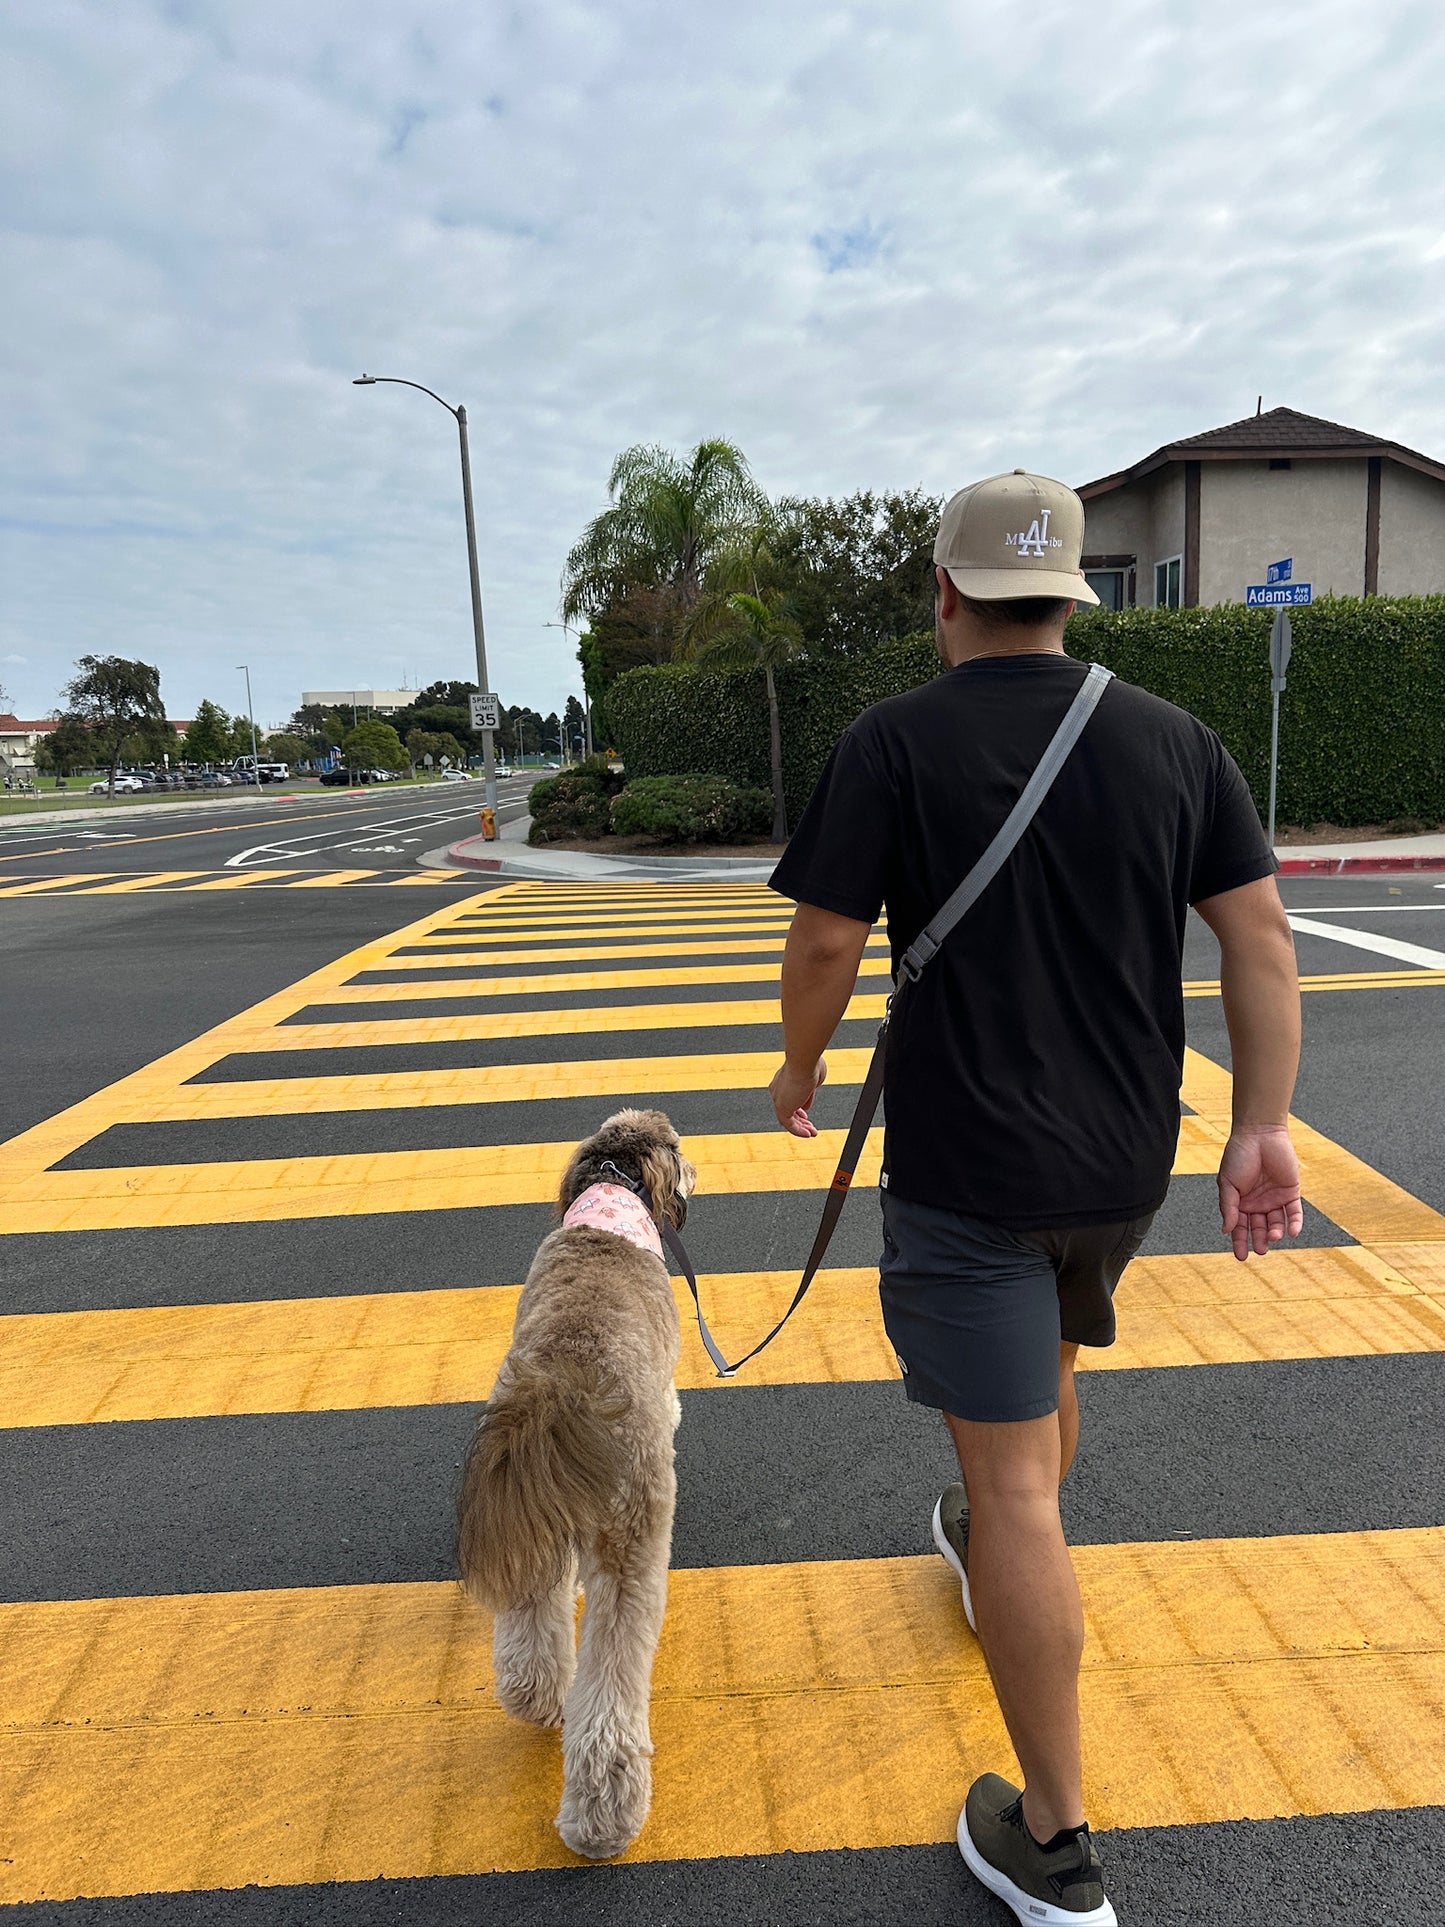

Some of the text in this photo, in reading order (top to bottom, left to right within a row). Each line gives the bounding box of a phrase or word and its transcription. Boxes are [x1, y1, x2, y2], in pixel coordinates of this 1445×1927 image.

[1248, 586, 1309, 603] Adams Ave
[1293, 594, 1309, 603] 500
[472, 696, 496, 704] SPEED
[475, 713, 496, 726] 35
